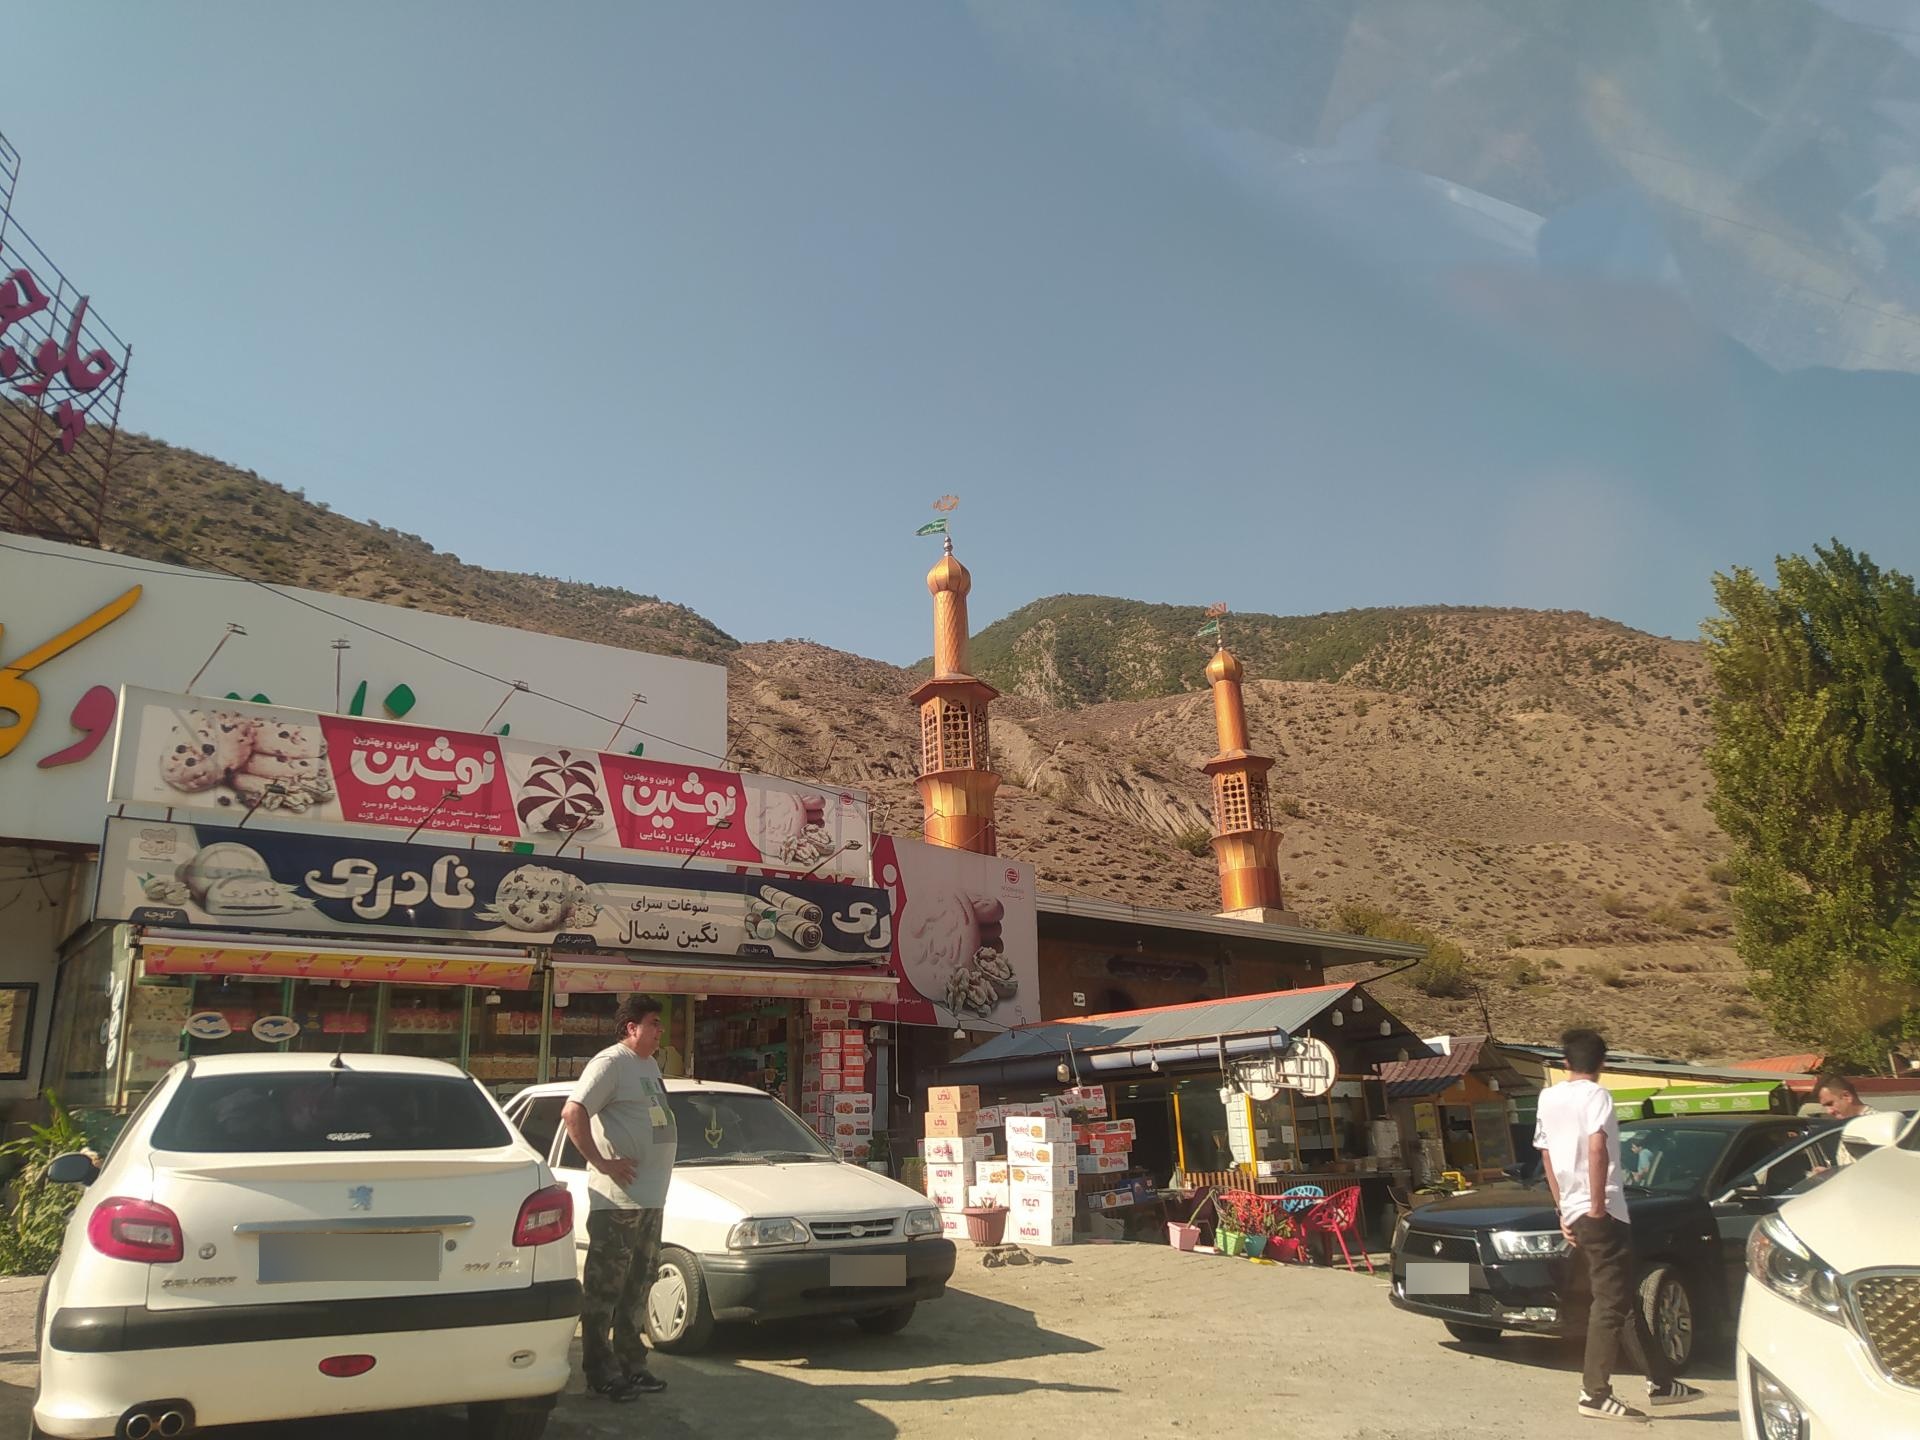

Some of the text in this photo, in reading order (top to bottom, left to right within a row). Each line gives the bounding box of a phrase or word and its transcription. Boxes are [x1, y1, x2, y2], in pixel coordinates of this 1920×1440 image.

[353, 736, 384, 748] بهترین
[394, 741, 418, 752] اولین
[350, 736, 496, 800] نوشین
[623, 772, 648, 782] بهترین
[656, 778, 675, 786] اولین
[622, 772, 736, 829] نوشین
[640, 829, 672, 842] رضایی
[711, 840, 736, 850] سوپر
[304, 854, 475, 920] نادری
[630, 896, 709, 916] سوغات سرای
[144, 910, 178, 921] کلوچه
[618, 920, 718, 948] نگین شمال
[1020, 1228, 1040, 1236] NADI
